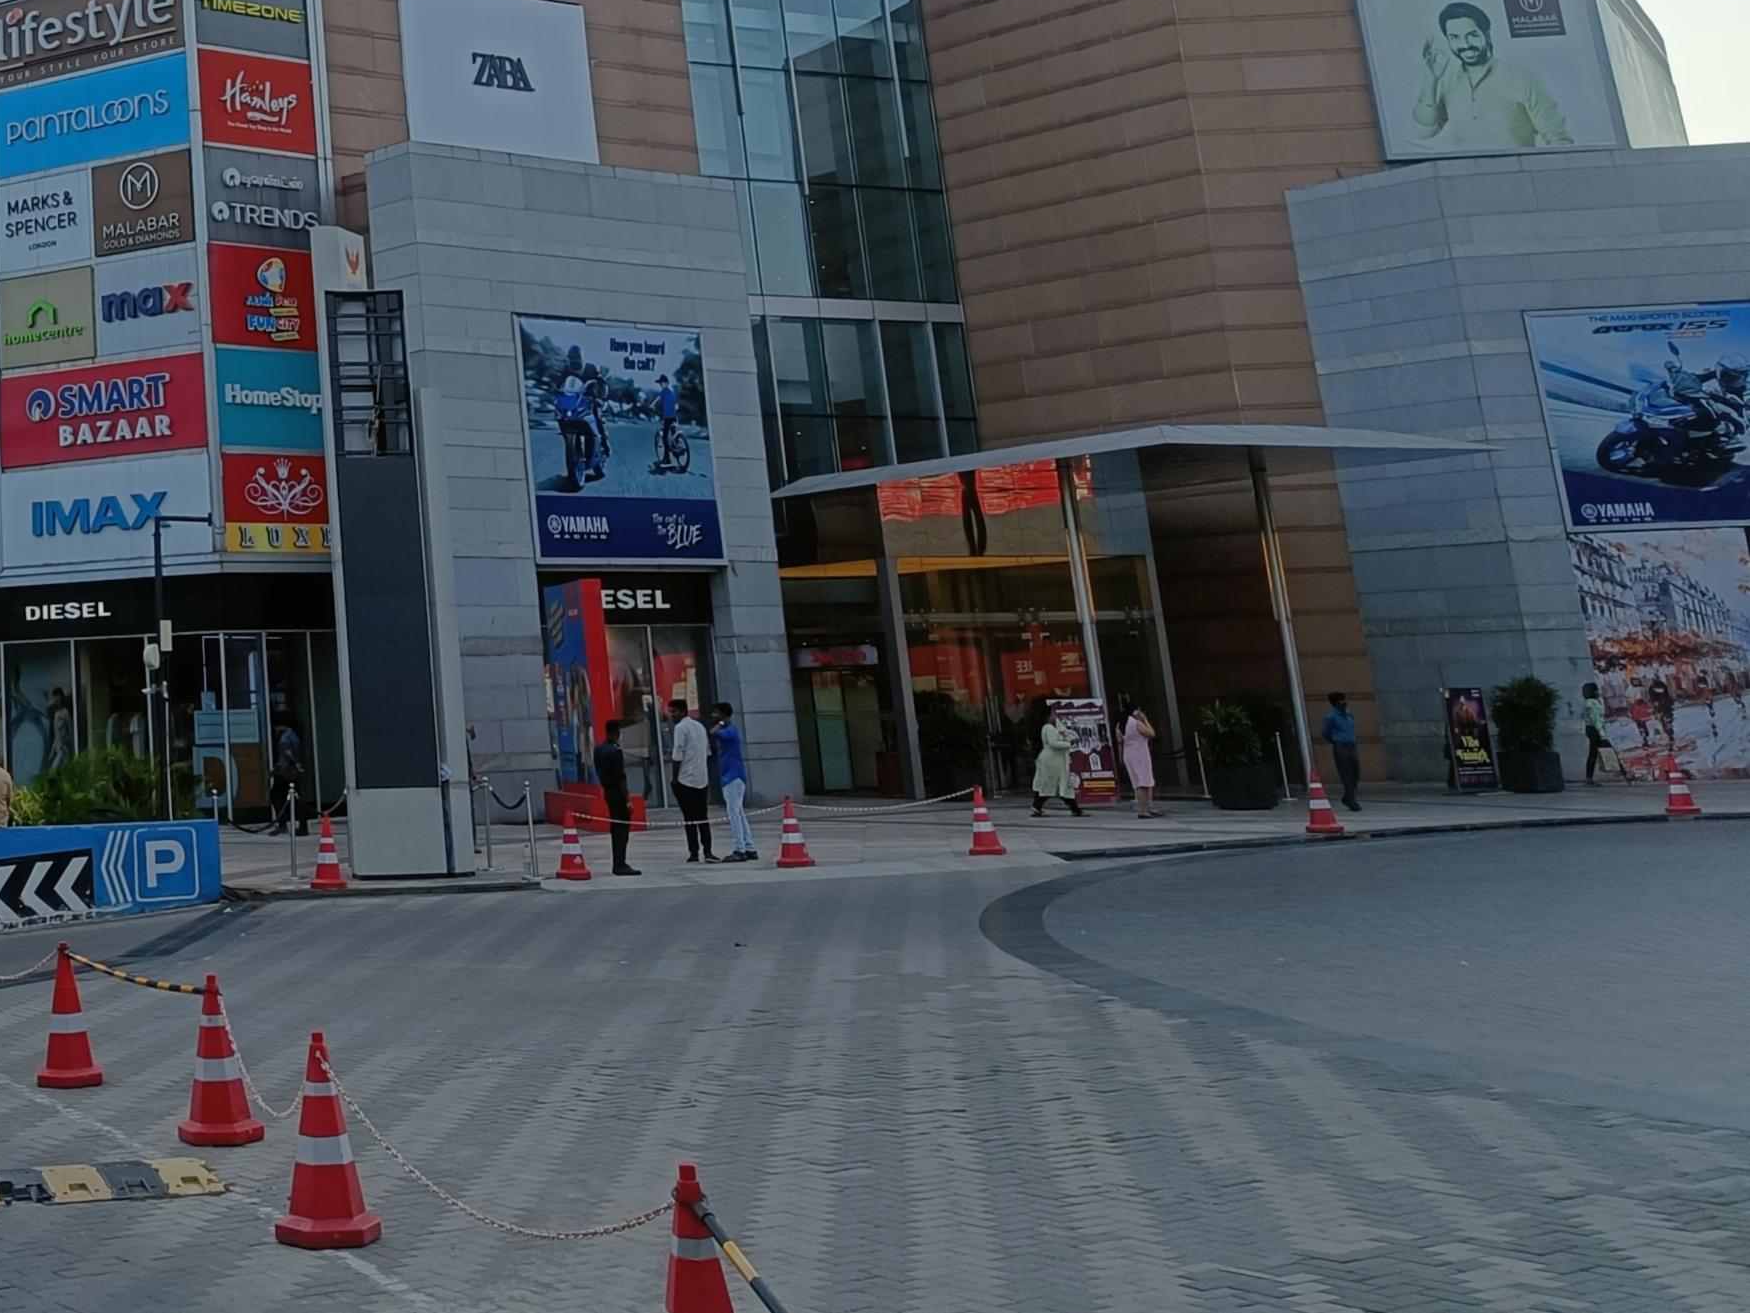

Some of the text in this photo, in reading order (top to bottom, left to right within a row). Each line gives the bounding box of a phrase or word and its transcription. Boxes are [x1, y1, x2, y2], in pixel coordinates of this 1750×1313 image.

[1512, 14, 1557, 23] MALABAR
[0, 37, 176, 84] YOUR STYLE YOUR STORE
[219, 70, 297, 126] Hamleys
[7, 191, 74, 217] MARKS &
[5, 212, 77, 238] SPENCER
[102, 213, 179, 238] MALABAR
[230, 202, 319, 230] TRENDS
[28, 240, 57, 251] LONDON
[103, 229, 180, 250] GOLD & DIAMONDS
[101, 282, 193, 323] max
[247, 314, 300, 333] FUN CITY
[1588, 310, 1730, 323] THE MAXI SPORTS SCOOTER
[1677, 319, 1729, 330] 155
[4, 325, 84, 346] homecentre
[610, 338, 665, 356] Have you heard
[624, 356, 655, 371] the call?
[58, 373, 170, 419] SMART
[225, 383, 323, 415] HomeStop
[58, 414, 172, 448] BAZAAR
[31, 491, 168, 537] IMAX
[1596, 502, 1655, 518] YAMAHA
[561, 516, 610, 534] YAMAHA
[666, 524, 703, 550] BLUE
[25, 601, 112, 621] DIESEL
[601, 589, 671, 610] ESEL
[145, 839, 186, 889] P
